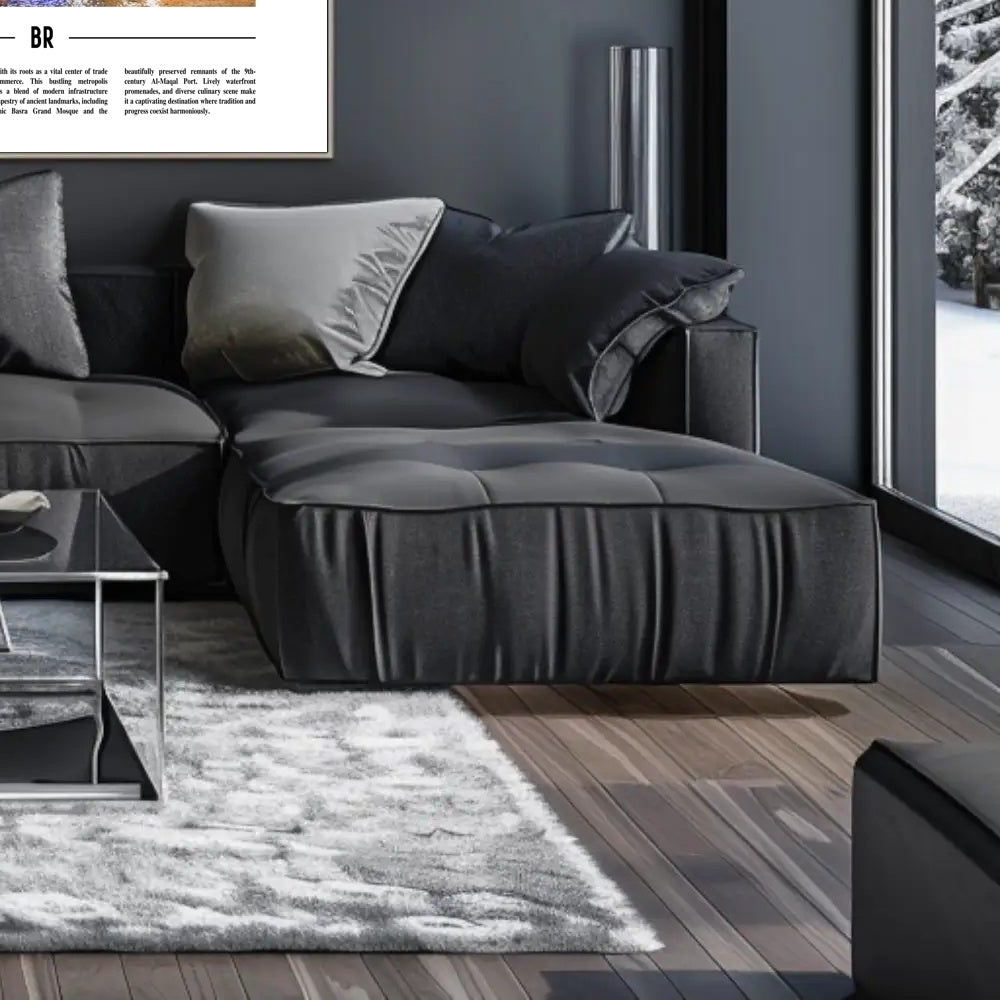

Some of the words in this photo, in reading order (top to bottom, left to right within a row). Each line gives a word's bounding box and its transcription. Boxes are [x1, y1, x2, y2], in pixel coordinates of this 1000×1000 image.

[31, 26, 53, 48] BR
[19, 67, 34, 75] roots
[50, 67, 63, 75] vital
[65, 67, 83, 75] center
[84, 67, 91, 75] of
[92, 67, 108, 75] trade
[124, 67, 154, 77] beautifully
[159, 67, 186, 77] preserved
[190, 67, 217, 75] remnants
[221, 67, 227, 75] of
[231, 67, 240, 75] the
[244, 67, 256, 75] 9th-
[30, 77, 43, 85] This
[49, 77, 72, 86] bustling
[78, 77, 108, 86] metropolis
[124, 77, 145, 86] century
[152, 77, 178, 86] Al-Maqal
[183, 77, 198, 85] Port.
[203, 77, 220, 86] Lively
[226, 77, 256, 85] waterfront
[14, 87, 29, 95] blend
[33, 87, 39, 95] of
[42, 87, 65, 95] modern
[68, 87, 108, 95] infrastructure
[124, 87, 160, 96] promenades,
[162, 87, 173, 95] and
[175, 87, 195, 95] diverse
[197, 87, 220, 96] culinary
[240, 87, 256, 95] make
[19, 97, 26, 105] of
[26, 97, 47, 105] ancient
[48, 97, 80, 106] landmarks,
[81, 97, 108, 106] including
[124, 97, 129, 105] it
[135, 97, 166, 106] captivating
[167, 97, 199, 105] destination
[200, 97, 217, 105] where
[219, 97, 244, 105] tradition
[245, 97, 256, 105] and
[11, 107, 28, 115] Basra
[32, 107, 51, 115] Grand
[56, 107, 78, 116] Mosque
[83, 107, 94, 115] and
[99, 107, 108, 115] the
[149, 107, 169, 115] coexist
[170, 107, 210, 116] harmoniously.
